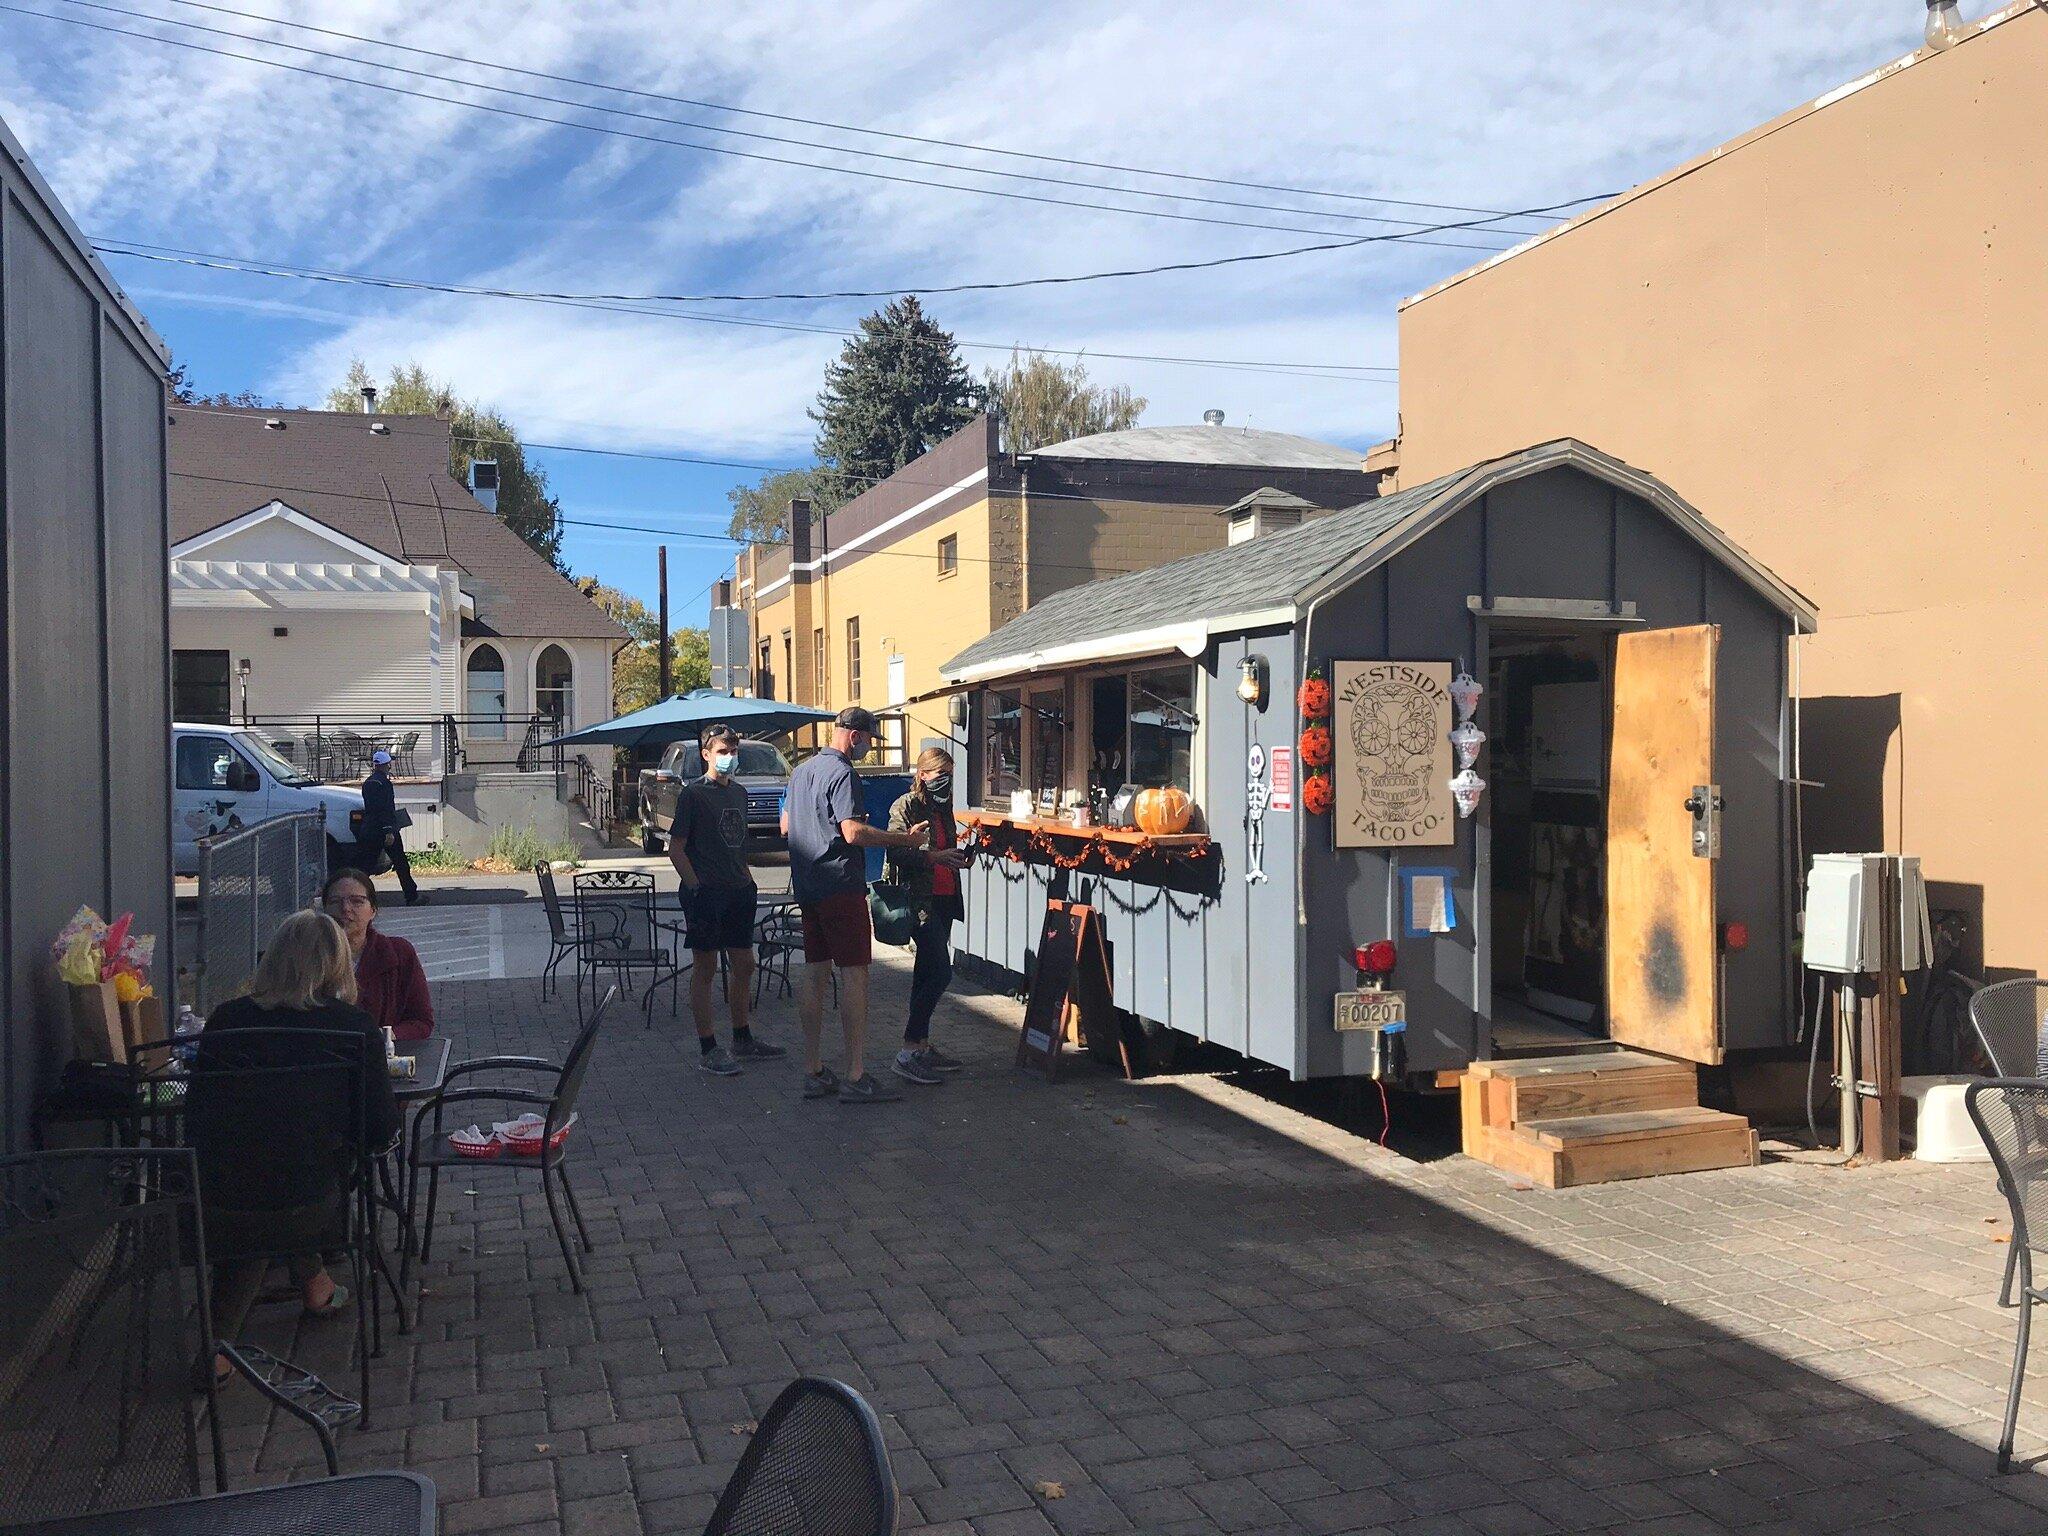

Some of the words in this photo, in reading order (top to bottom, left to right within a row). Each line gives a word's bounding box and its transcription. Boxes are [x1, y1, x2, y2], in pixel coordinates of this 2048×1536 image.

[1339, 665, 1448, 707] WESTSIDE
[1351, 810, 1405, 841] TACO
[1351, 1004, 1402, 1022] 00207
